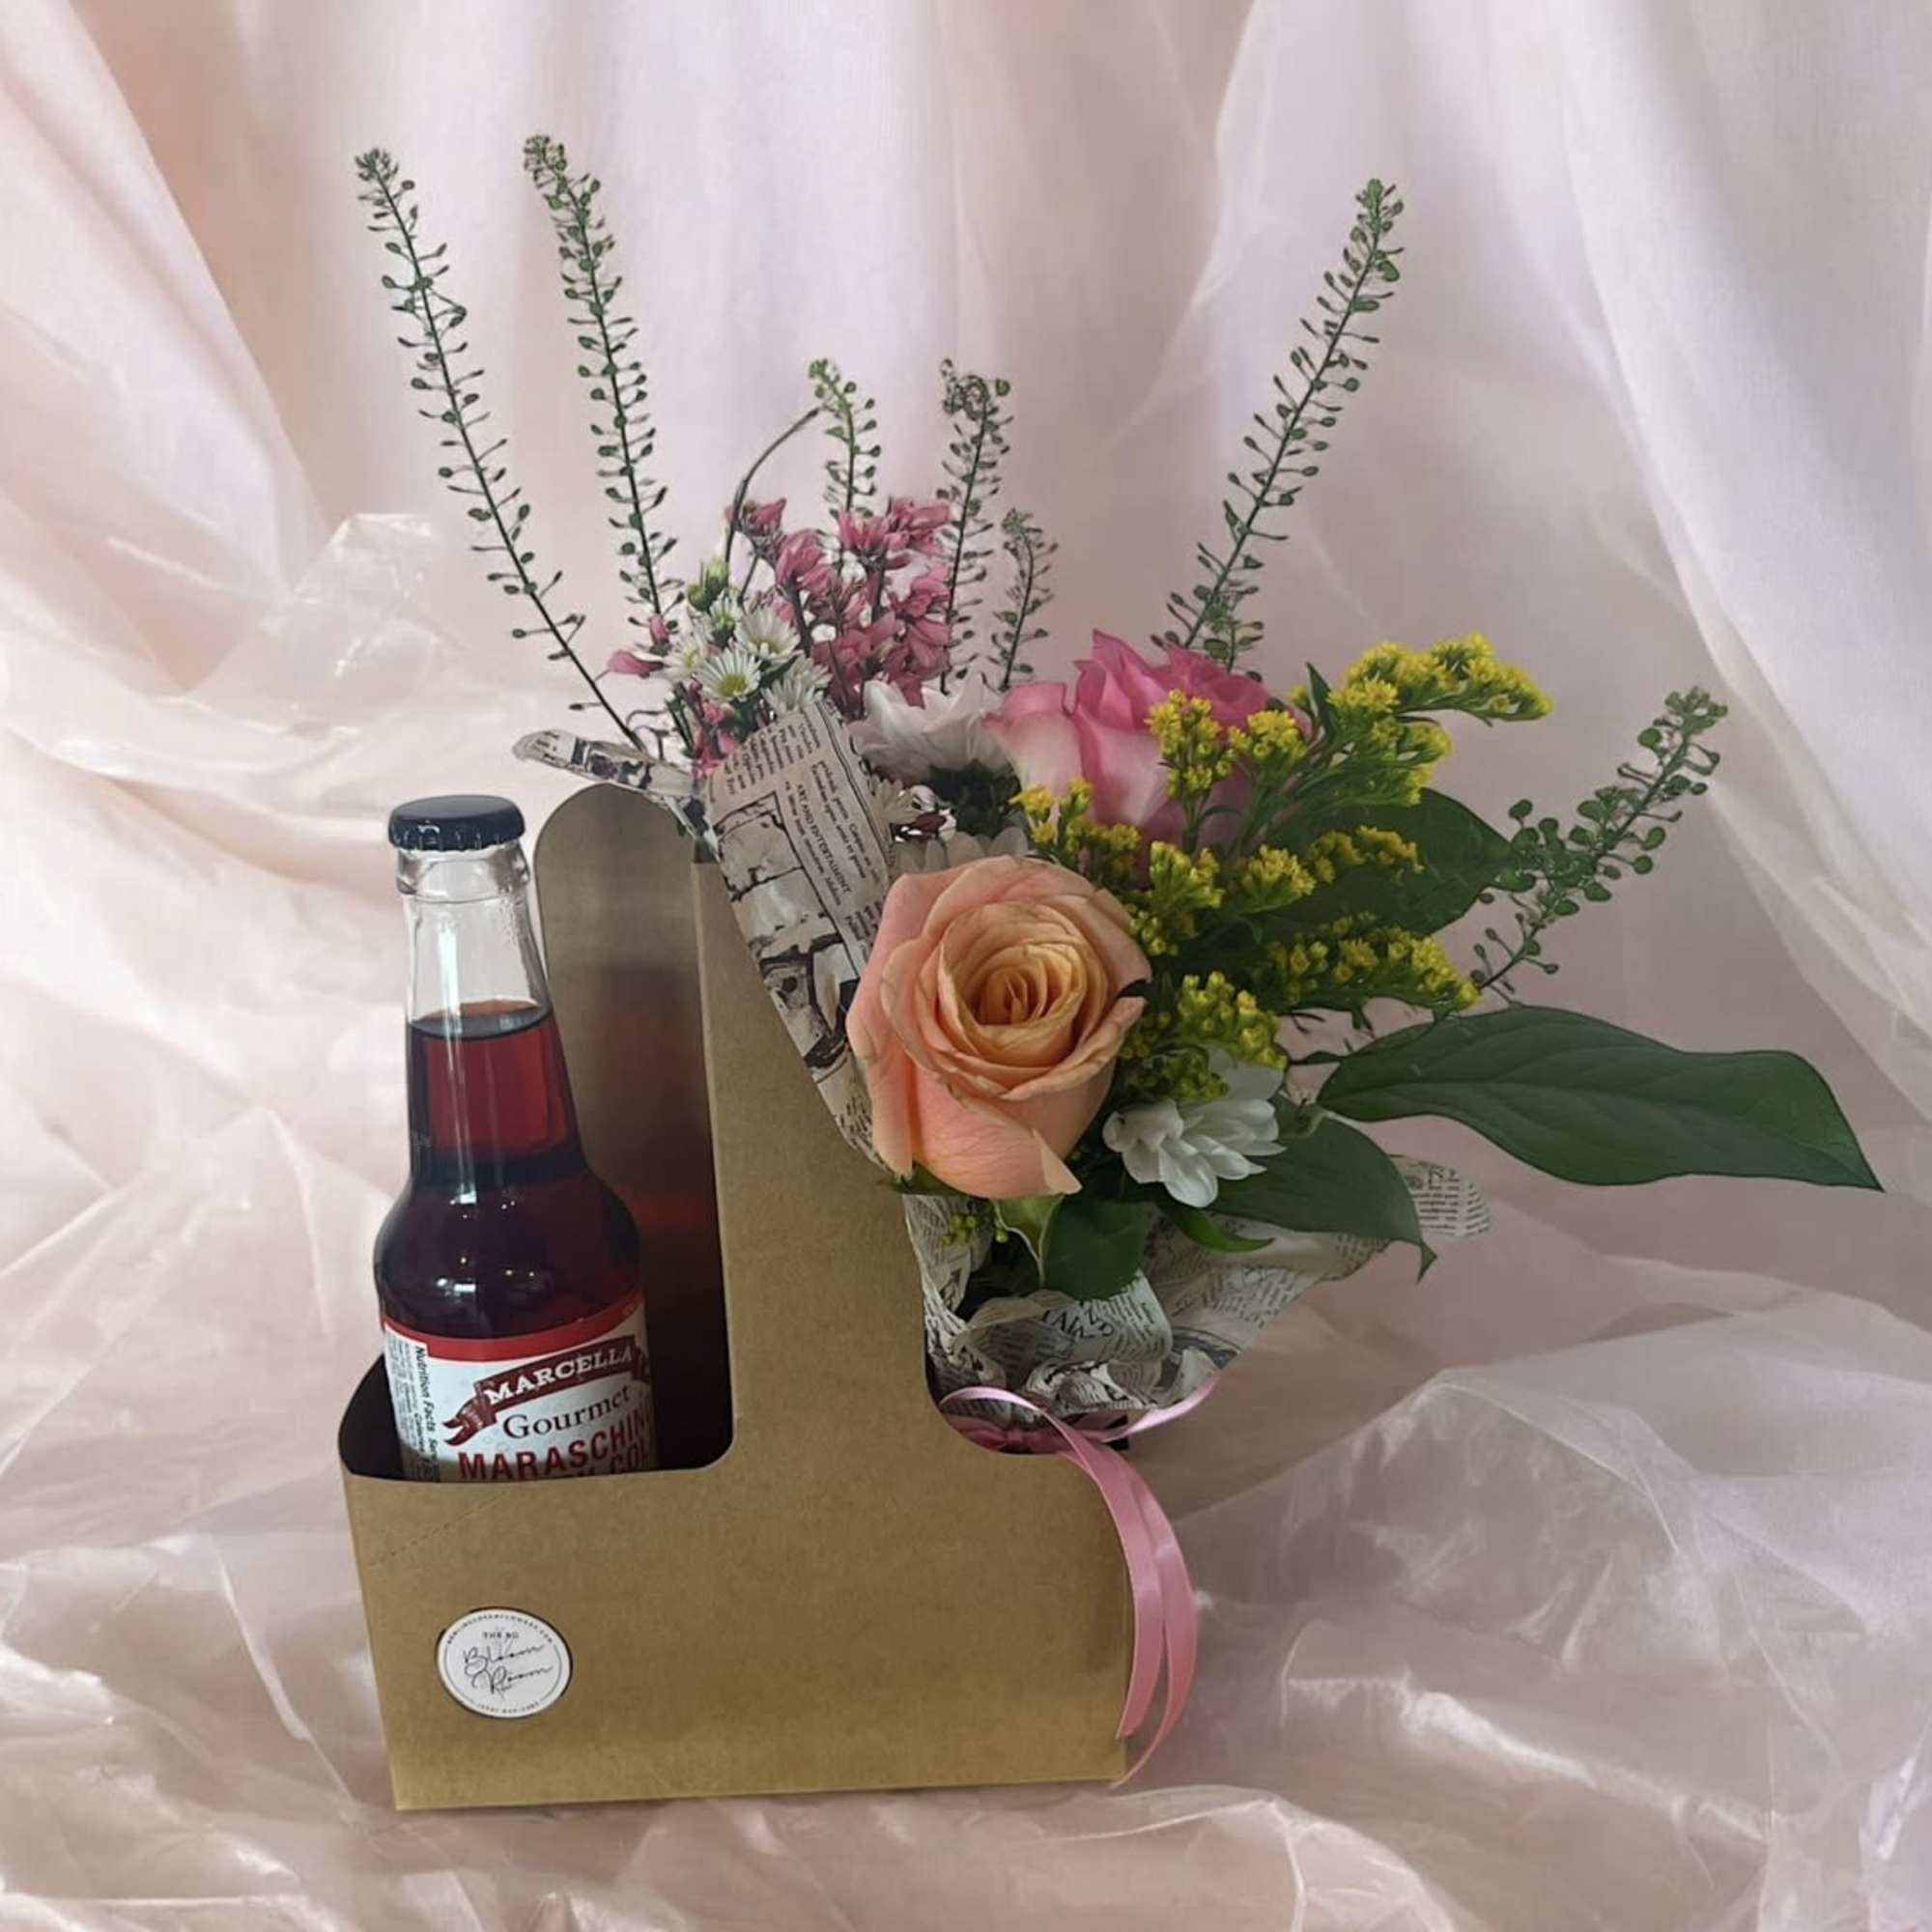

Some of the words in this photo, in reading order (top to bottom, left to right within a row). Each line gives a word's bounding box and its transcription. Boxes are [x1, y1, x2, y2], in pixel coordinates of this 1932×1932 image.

[415, 1346, 431, 1399] Nutrition
[424, 1401, 437, 1433] Facts
[483, 1347, 634, 1406] MARCELLA
[502, 1385, 630, 1439] Gourmet
